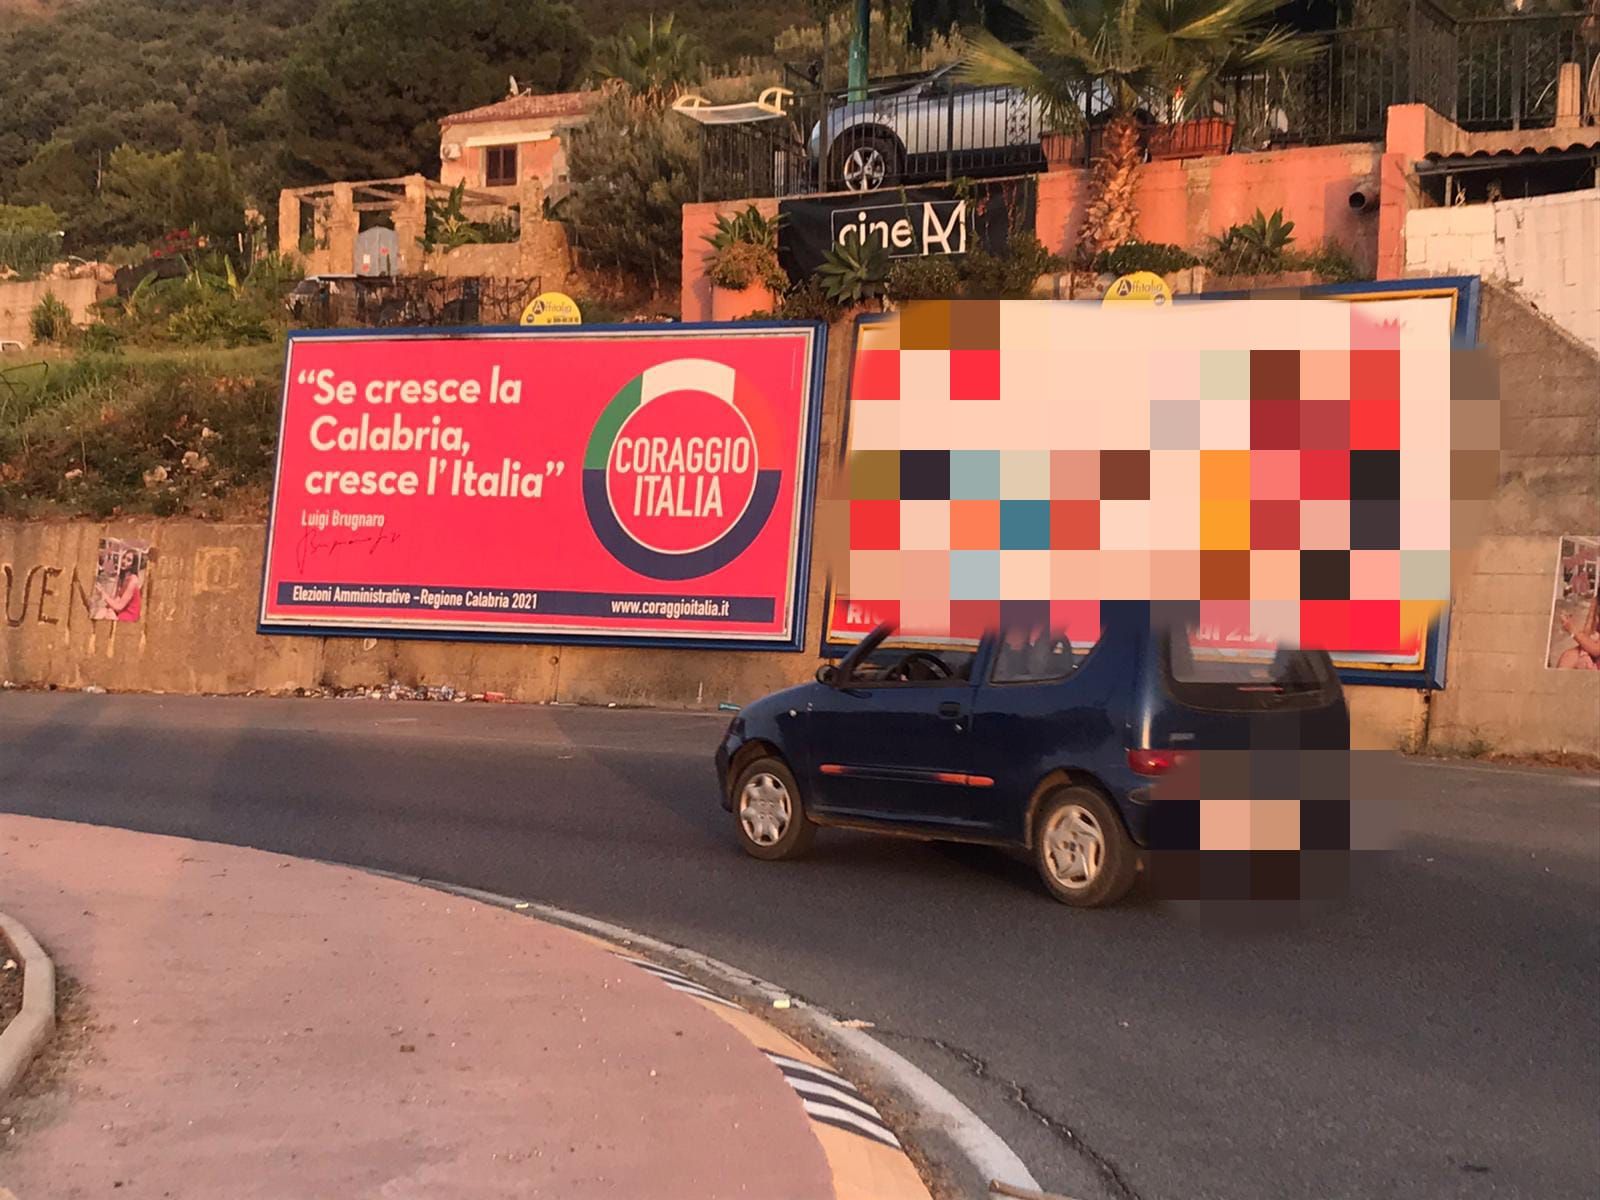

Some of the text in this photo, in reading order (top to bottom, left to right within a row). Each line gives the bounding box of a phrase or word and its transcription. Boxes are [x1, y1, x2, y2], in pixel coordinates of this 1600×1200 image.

[838, 211, 913, 249] cine
[297, 365, 522, 405] “Se cresce la
[309, 412, 470, 456] Calabria,
[615, 436, 751, 474] CORAGGIO
[304, 469, 419, 495] cresce
[633, 475, 724, 518] ITALIA
[301, 509, 385, 532] Luigi Brugnaro
[292, 585, 332, 602] Elezioni
[333, 586, 410, 604] Amministrative
[465, 590, 510, 609] Calabria
[511, 592, 538, 610] 2021
[611, 598, 730, 619] www.coraggioitalia.it
